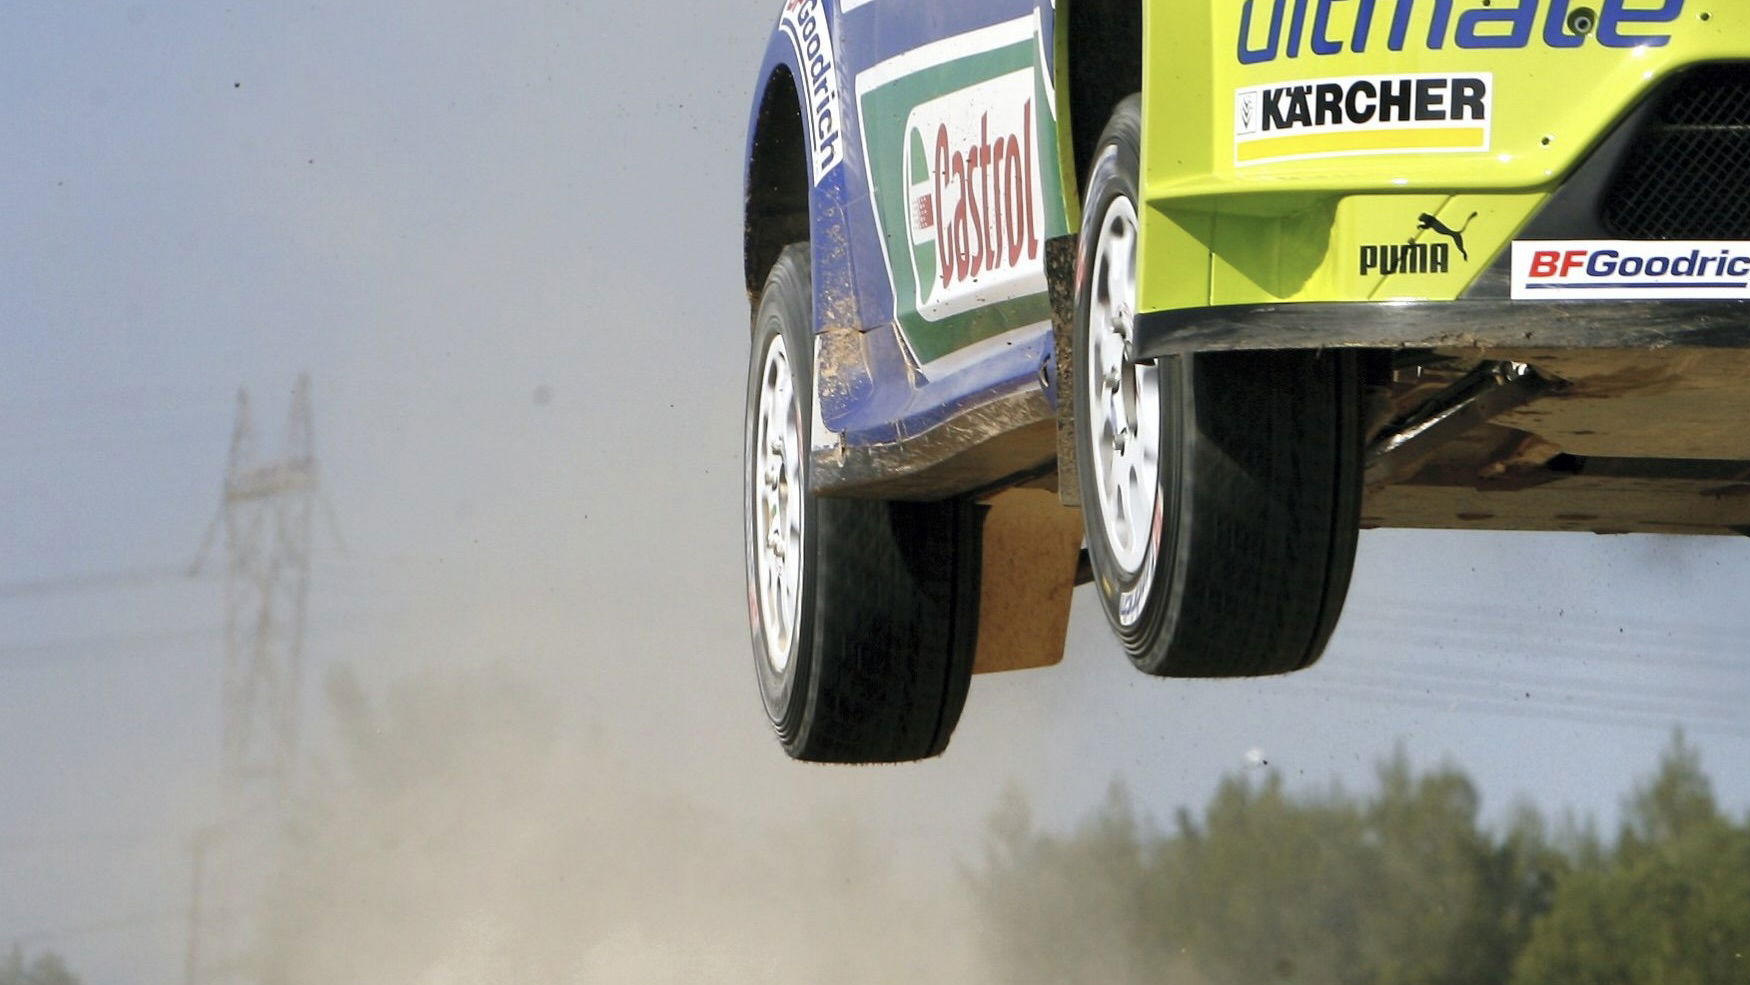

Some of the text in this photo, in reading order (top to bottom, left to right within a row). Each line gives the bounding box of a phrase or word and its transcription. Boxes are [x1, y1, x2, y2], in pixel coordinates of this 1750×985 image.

[1261, 77, 1486, 132] KÄRCHER
[934, 95, 1039, 290] Castrol
[1360, 241, 1449, 276] PUMA
